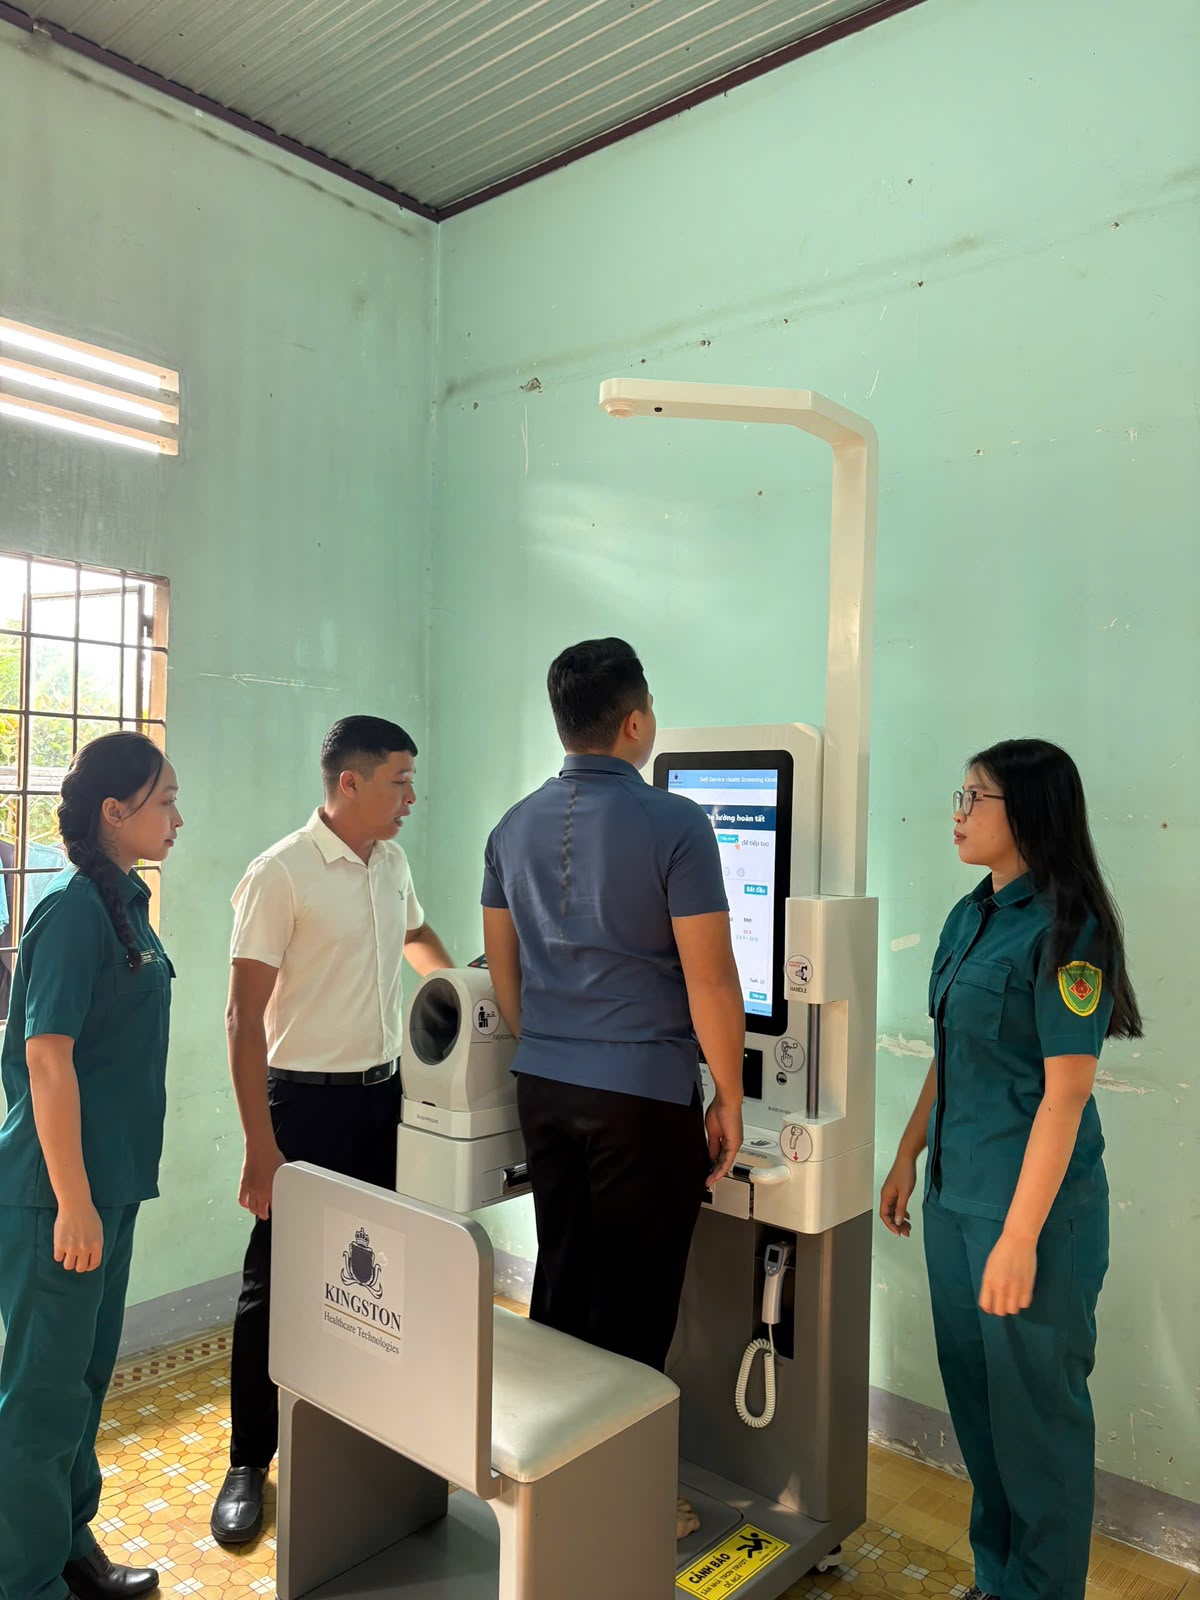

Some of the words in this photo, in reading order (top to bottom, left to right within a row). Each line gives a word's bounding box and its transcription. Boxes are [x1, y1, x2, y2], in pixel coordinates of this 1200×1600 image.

[716, 813, 735, 823] lường
[736, 814, 754, 822] hoàn
[754, 813, 766, 823] tất
[325, 1282, 401, 1332] KINGSTON
[324, 1311, 357, 1334] Healthcare
[356, 1326, 400, 1355] Technologies
[688, 1568, 713, 1584] CẢNH
[713, 1552, 731, 1569] BÁO
